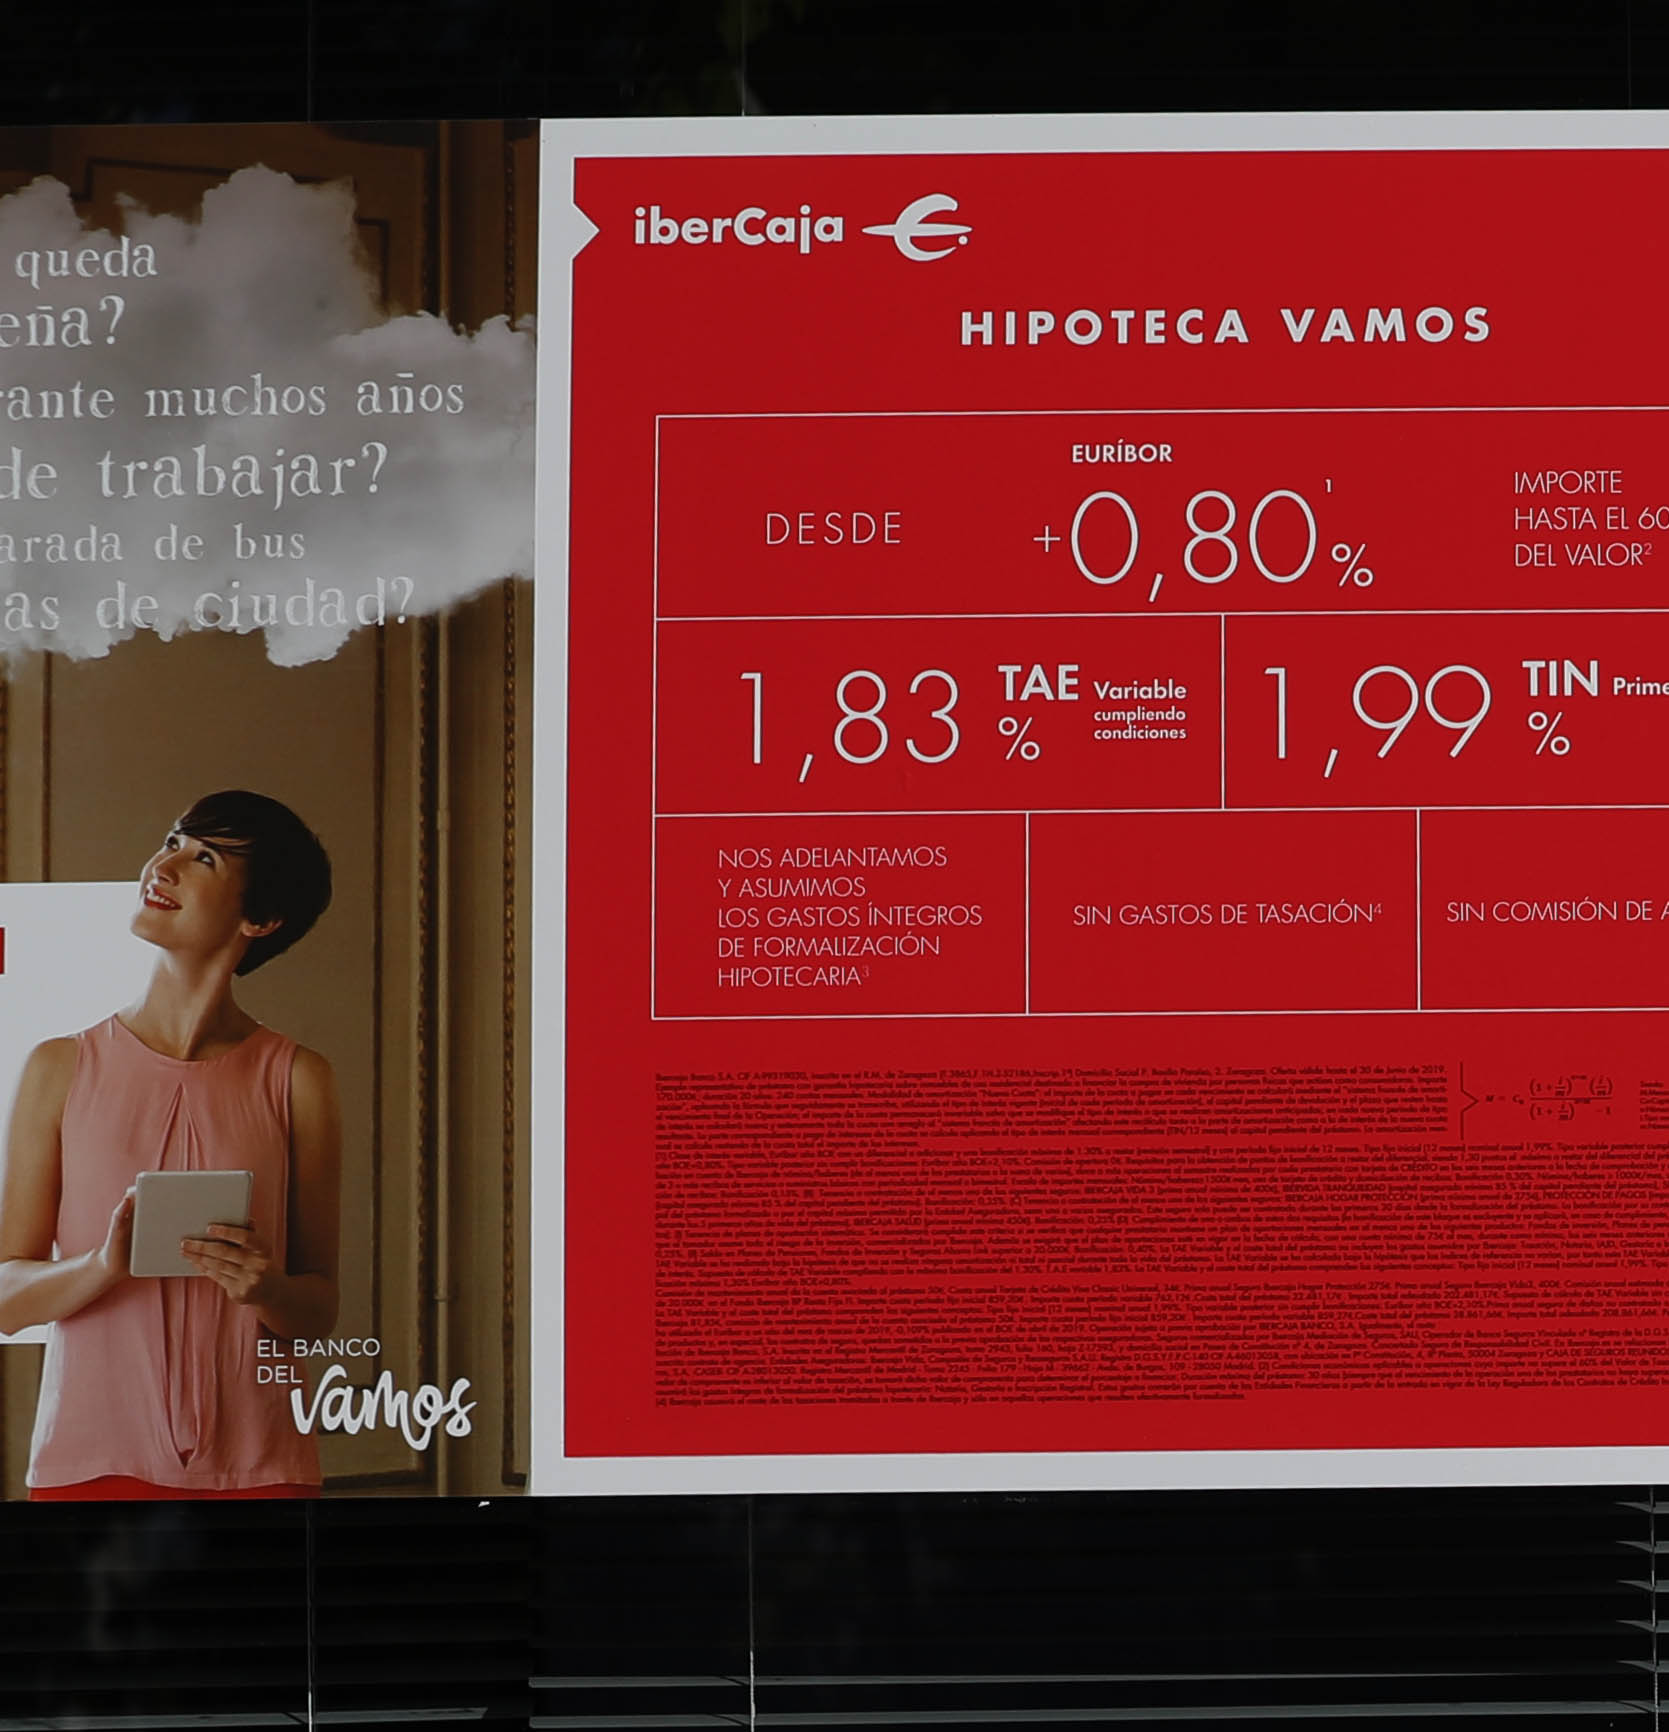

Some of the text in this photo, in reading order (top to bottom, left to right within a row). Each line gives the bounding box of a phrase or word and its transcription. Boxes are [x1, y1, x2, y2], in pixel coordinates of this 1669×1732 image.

[635, 205, 843, 253] iberCaja
[16, 235, 157, 289] queda
[0, 296, 124, 347] eña?
[962, 307, 1489, 345] HIPOTECA VAMOS
[0, 373, 463, 420] ante muchos años
[1073, 439, 1172, 462] EURÍBOR
[97, 442, 387, 510] trabajar?
[1515, 471, 1622, 494] IMPORTE
[767, 512, 900, 544] DESDE
[1515, 507, 1596, 530] HASTA
[1607, 507, 1629, 529] EL
[155, 524, 203, 560] de
[234, 523, 304, 559] bus
[1516, 544, 1556, 566] DEL
[5, 576, 415, 631] as de ciudad?
[998, 664, 1186, 700] TAE Variable
[1522, 660, 1598, 696] TIN
[741, 670, 959, 782] 1,83
[1094, 706, 1186, 724] cumpliendo
[1265, 665, 1490, 777] 1,99
[999, 717, 1040, 760] %
[1094, 725, 1186, 740] condiciones
[1528, 712, 1570, 755] %
[719, 847, 947, 868] NOS ADELANTAMOS
[718, 877, 865, 897] Y ASUMIMOS
[719, 902, 982, 928] LOS GASTOS ÍNTEGROS
[1074, 905, 1110, 925] SIN
[1119, 904, 1212, 925] GASTOS
[1221, 904, 1247, 924] DE
[1447, 902, 1484, 922] SIN
[1493, 896, 1616, 921] COMISIÓN
[1626, 901, 1652, 920] DE
[719, 931, 939, 957] DE FORMALIZACIÓN
[258, 1338, 380, 1357] EL BANCO
[258, 1365, 303, 1383] DEL
